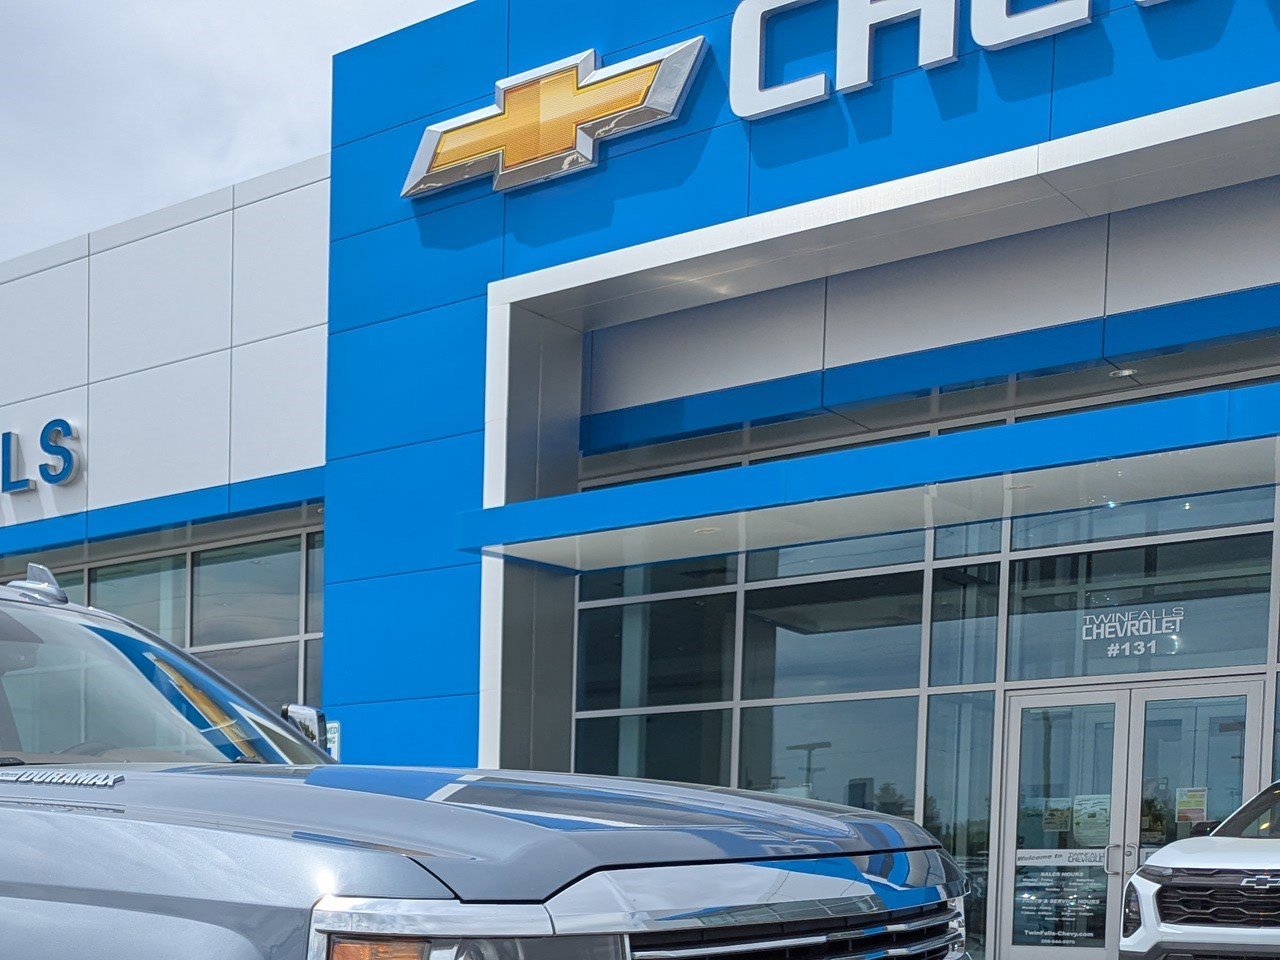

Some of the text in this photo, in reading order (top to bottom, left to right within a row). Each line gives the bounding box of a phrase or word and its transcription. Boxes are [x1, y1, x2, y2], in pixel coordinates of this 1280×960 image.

[1082, 607, 1184, 625] TWINFALLS
[1082, 616, 1184, 640] CHEVROLET
[1107, 640, 1156, 657] #131
